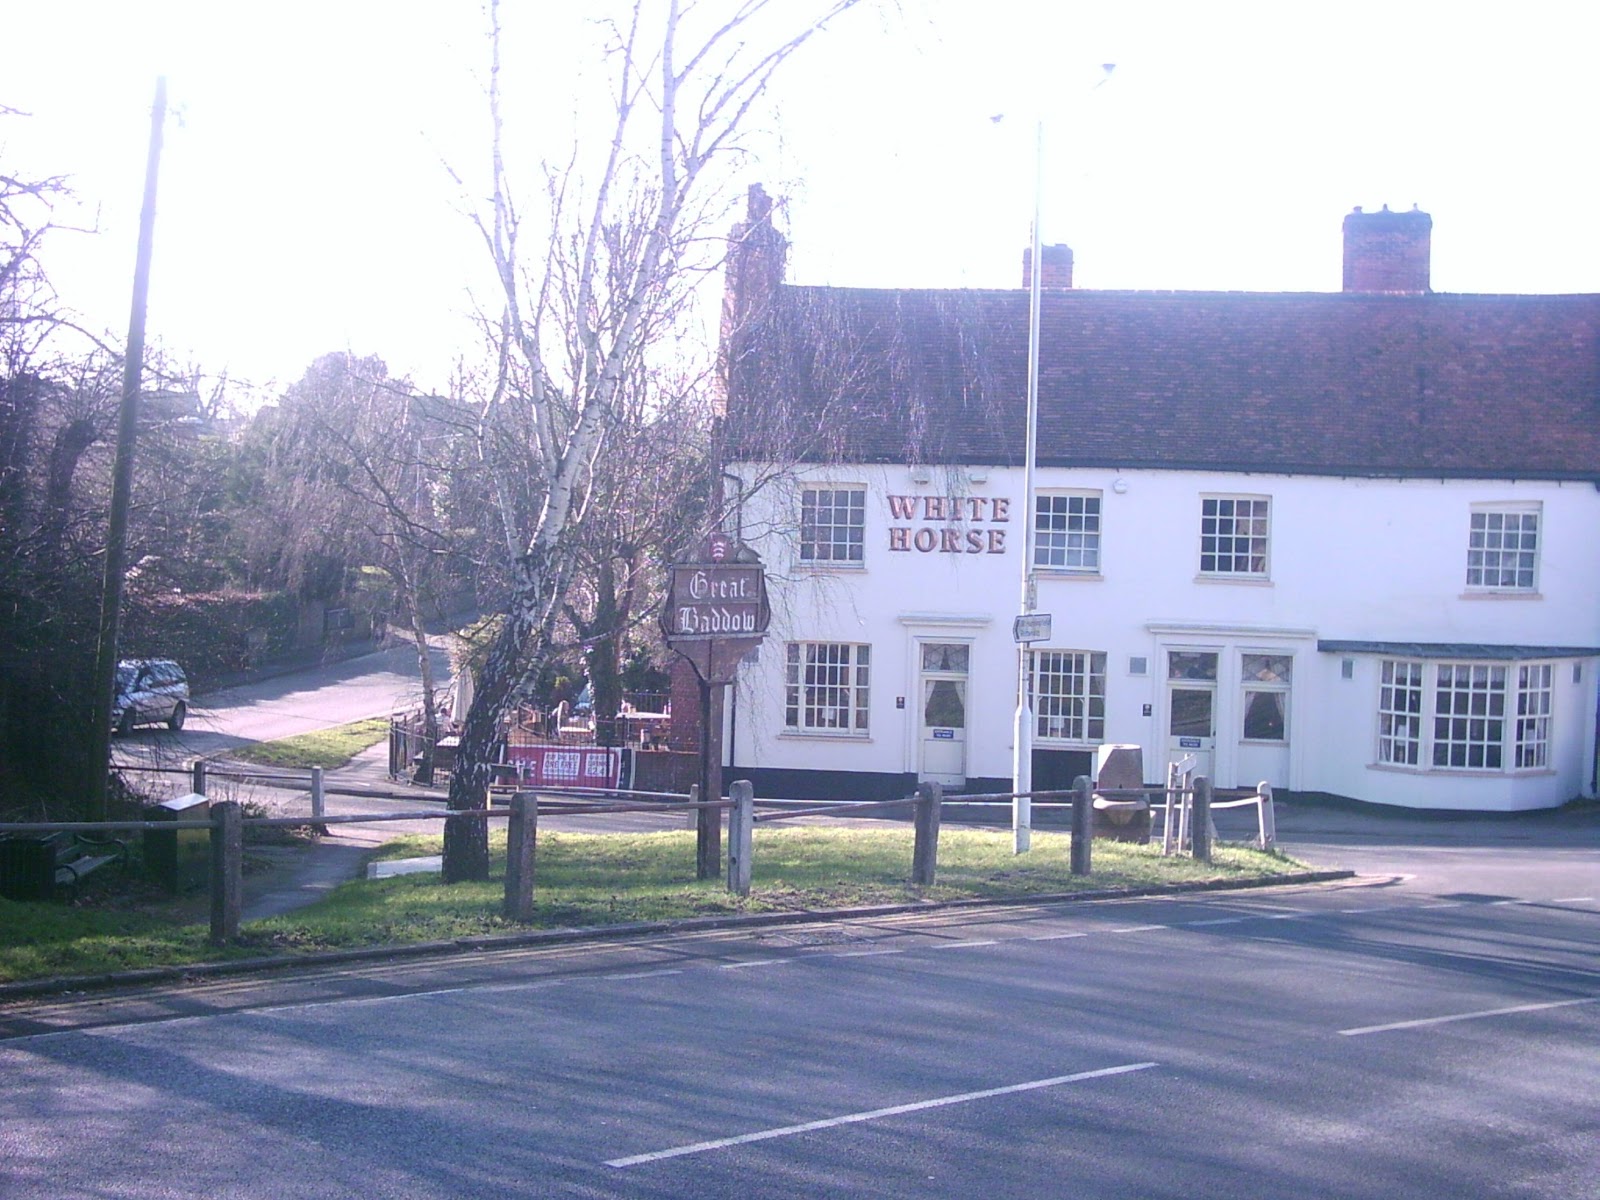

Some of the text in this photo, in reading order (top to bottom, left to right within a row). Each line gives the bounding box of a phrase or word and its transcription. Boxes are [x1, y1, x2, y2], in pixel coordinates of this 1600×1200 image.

[887, 495, 1011, 522] WHITE
[888, 527, 1007, 554] HORSE
[689, 571, 750, 599] Great
[679, 607, 756, 633] Baddow
